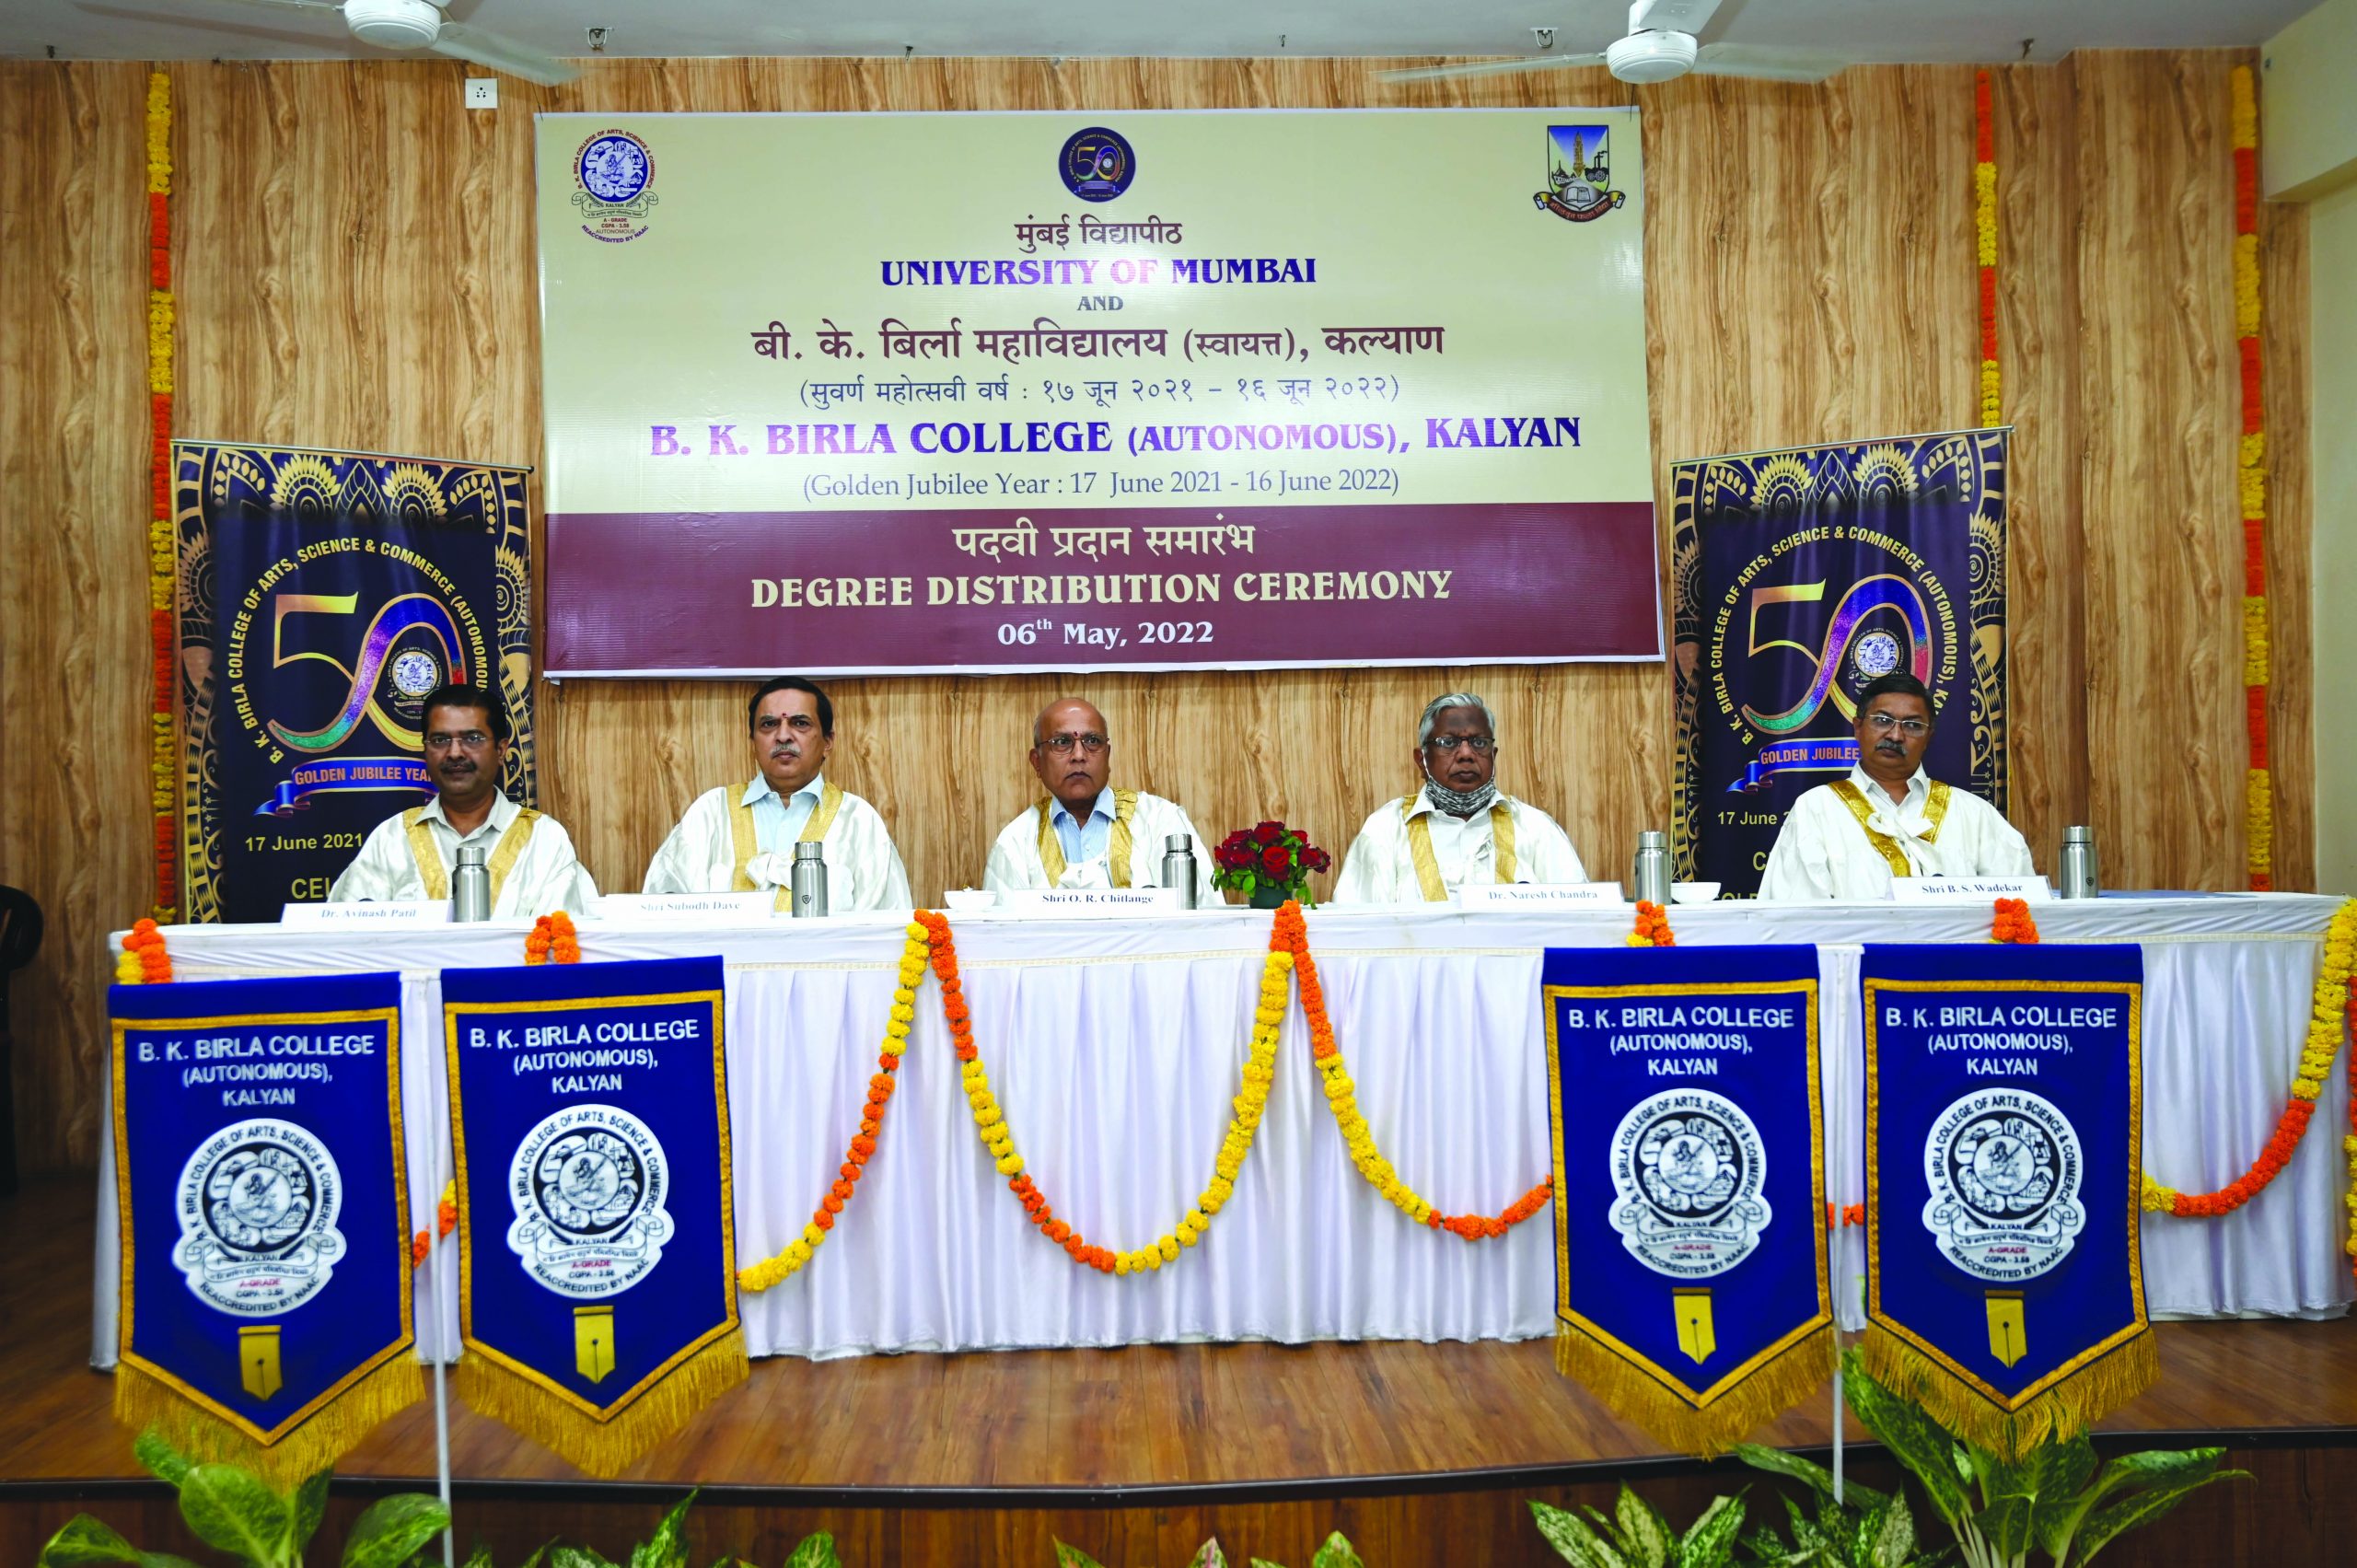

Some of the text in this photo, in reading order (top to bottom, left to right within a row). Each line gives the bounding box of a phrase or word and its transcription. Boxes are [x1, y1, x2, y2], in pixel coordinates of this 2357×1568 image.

[1015, 215, 1183, 253] मुंबई विद्यापीठ
[880, 258, 1317, 286] UNIVERSITY OF MUMBAI
[1076, 296, 1124, 312] AND
[750, 320, 803, 360] बी.
[816, 318, 865, 360] के.
[878, 318, 962, 360] बिर्ला
[972, 316, 1168, 366] महाविद्यालय
[1321, 326, 1446, 356] कल्याण
[800, 373, 865, 410] (सुवर्ण
[875, 373, 967, 403] महोत्सवी
[976, 373, 1009, 402] वर्ष
[1043, 379, 1074, 403] १७
[1083, 379, 1118, 408] जून
[1132, 378, 1193, 402] २०२१
[1237, 378, 1267, 402] १६
[1277, 378, 1311, 408] जून
[1326, 373, 1399, 402] २०२२)
[650, 417, 1582, 457] B. K. BIRLA COLLEGE (AUTONOMOUS), KALYAN
[804, 472, 900, 503] (Golden
[906, 472, 988, 502] Jubilee
[995, 472, 1049, 495] Year
[1072, 471, 1097, 494] 17
[1109, 470, 1163, 497] June
[1170, 470, 1221, 493] 2021
[1246, 470, 1271, 493] 16
[1278, 470, 1331, 496] June
[1338, 468, 1399, 496] 2022)
[365, 539, 376, 552] &
[951, 513, 1257, 563] पदवी प्रदान समारंभ
[1771, 527, 1829, 557] SCIENCE
[1834, 526, 1844, 539] &
[297, 538, 360, 563] SCIENCE
[1849, 526, 1924, 573] COMMERCE
[258, 558, 299, 592] ARTS,
[380, 541, 456, 597] COMMERCE
[1737, 554, 1773, 587] ARTS,
[243, 588, 261, 610] OF
[751, 570, 1452, 608] DEGREE DISTRIBUTION CEREMONY
[1724, 585, 1740, 605] OF
[997, 619, 1213, 650] 06th May, 2022
[1711, 607, 1732, 668] COLLEGE
[1918, 570, 1957, 684] (AUTONOMOUS),
[228, 610, 252, 679] COLLEGE
[450, 595, 488, 692] (AUTONOMOU
[1741, 573, 1932, 736] 50
[267, 591, 467, 753] 50
[231, 683, 259, 729] BIRLA
[1712, 672, 1734, 714] BIRLA
[1729, 714, 1743, 731] K.
[254, 729, 271, 749] K.
[1742, 728, 1754, 745] B.
[269, 746, 284, 764] B.
[1761, 747, 1861, 765] GOLDEN JUBILEE
[295, 767, 431, 784] GOLDEN JUBILEE YEA
[1718, 811, 1778, 825] 17 June
[245, 833, 363, 852] 17 June 2021
[1042, 894, 1154, 904] Shri O. R. Chitlange
[1489, 890, 1598, 900] Dr. Naresh Chandra
[1922, 883, 2023, 893] Shri B. S. Wadekar
[1569, 1006, 1794, 1028] B. K. BIRLA COLLEGE
[1886, 1006, 2118, 1028] B. K. BIRLA COLLEGE
[470, 1019, 700, 1050] B. K. BIRLA COLLEGE
[1610, 1033, 1753, 1055] (AUTONOMOUS),
[1928, 1033, 2073, 1055] (AUTONOMOUS),
[138, 1035, 375, 1062] B. K. BIRLA COLLEGE
[182, 1063, 333, 1087] (AUTONOMOUS),
[514, 1049, 658, 1075] (AUTONOMOUS),
[1648, 1058, 1718, 1075] KALYAN
[1967, 1058, 2038, 1075] KALYAN
[222, 1087, 296, 1106] KALYAN
[552, 1074, 622, 1094] KALYAN
[1936, 1104, 1974, 1144] COLLEGE
[1975, 1096, 1988, 1110] OF
[1991, 1096, 2021, 1109] ARTS,
[2026, 1100, 2063, 1135] SCIENCE
[522, 1122, 559, 1164] COLLEGE
[560, 1114, 573, 1127] OF
[610, 1114, 647, 1148] SCIENCE
[1991, 1223, 2023, 1231] KALYAN
[1950, 1246, 2063, 1278] REACCREDITED BY NAAC
[534, 1263, 608, 1293] REACCREDITED
[610, 1277, 623, 1288] BY
